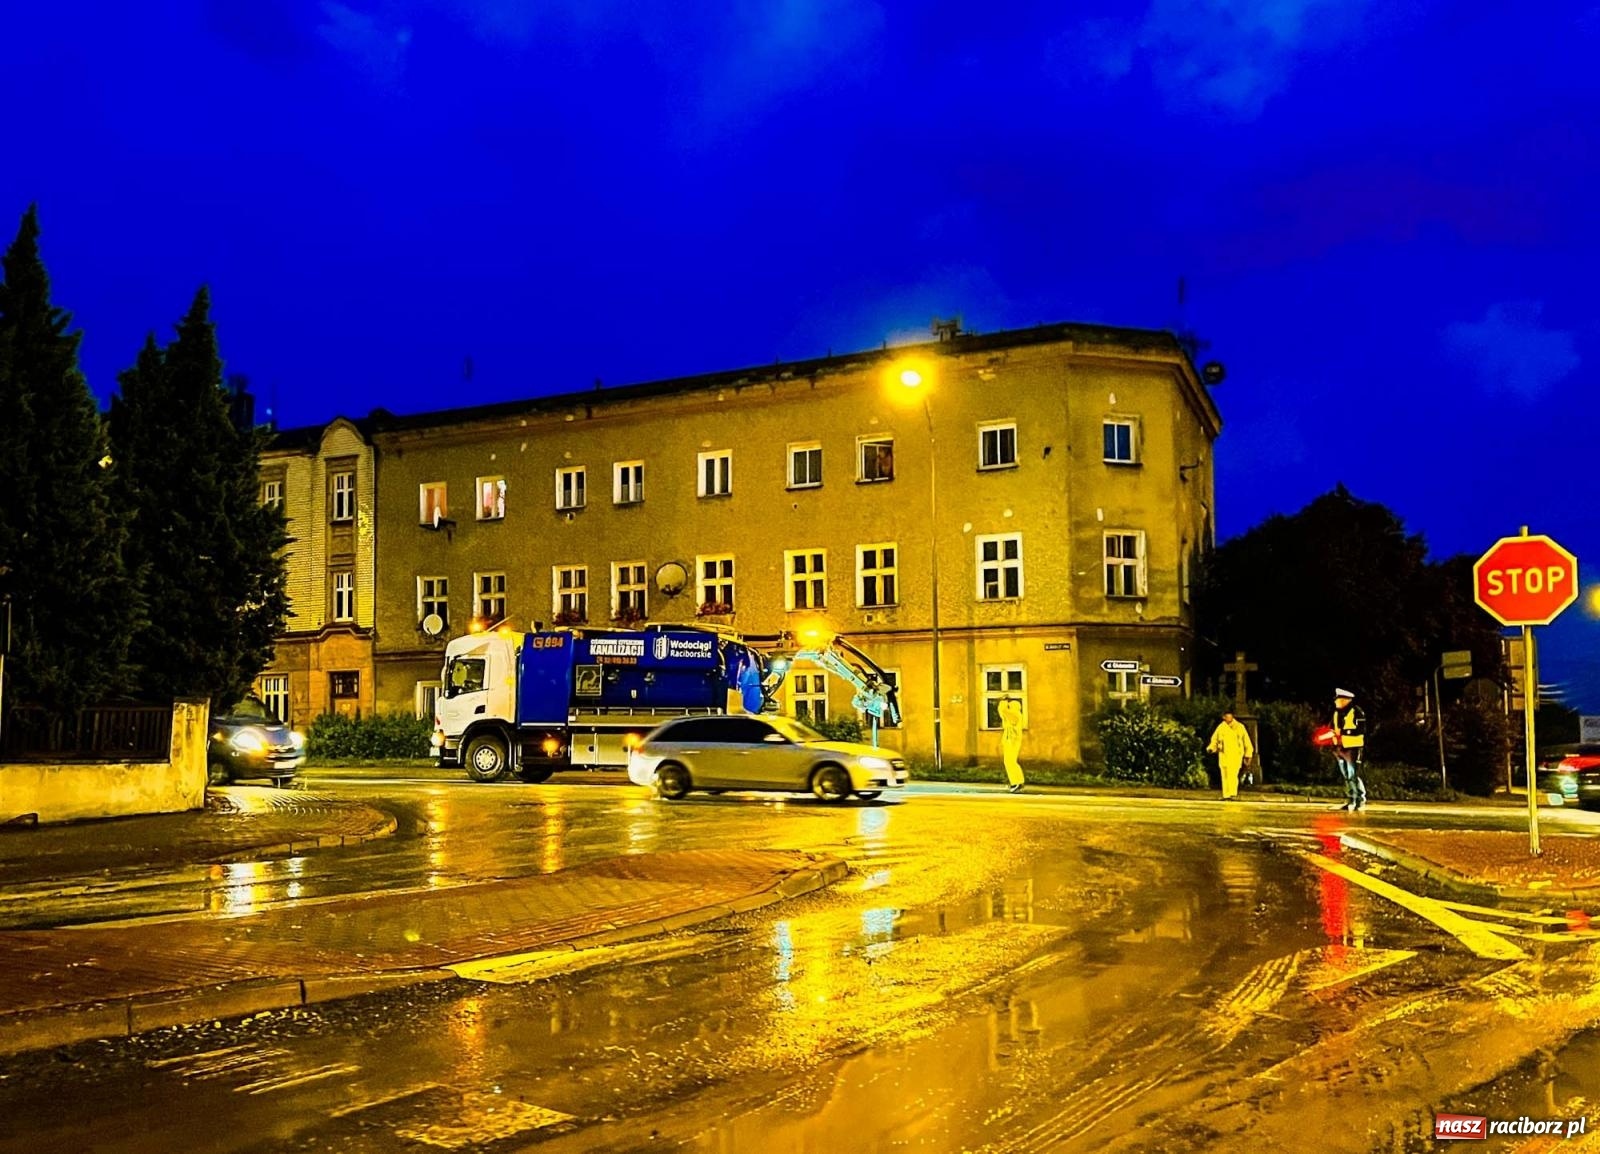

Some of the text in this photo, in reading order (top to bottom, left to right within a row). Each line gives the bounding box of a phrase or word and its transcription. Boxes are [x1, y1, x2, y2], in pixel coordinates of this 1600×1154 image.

[1487, 566, 1565, 596] STOP
[590, 644, 645, 657] KANALIZACJI
[670, 640, 712, 651] Wodociągi
[670, 650, 712, 659] Raciborskie
